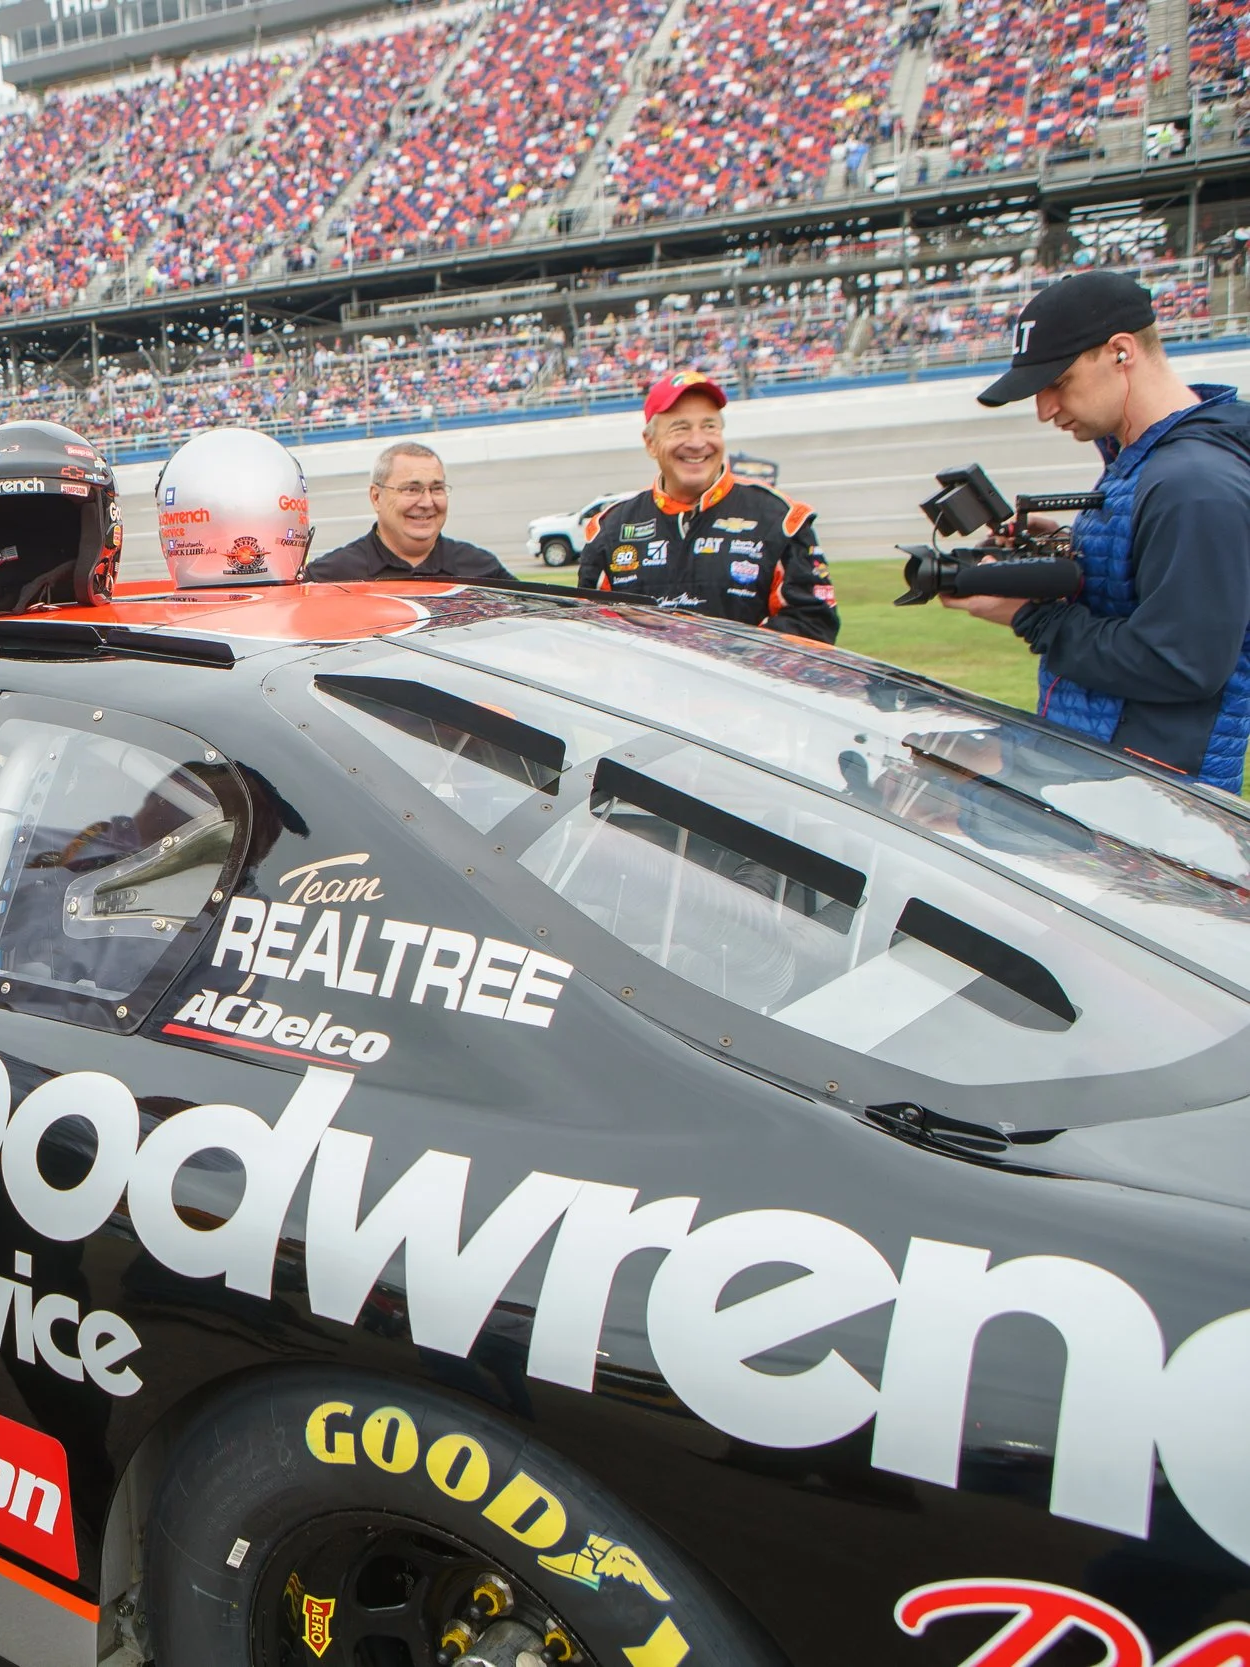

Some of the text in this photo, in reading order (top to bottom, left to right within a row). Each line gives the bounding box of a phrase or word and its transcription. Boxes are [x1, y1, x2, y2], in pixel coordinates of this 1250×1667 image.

[62, 485, 87, 495] SIMPSON
[615, 551, 634, 565] 50
[694, 537, 725, 554] CAT
[279, 853, 384, 904] Team
[211, 896, 574, 1028] REALTREE
[173, 988, 390, 1064] ACDelco
[310, 1602, 324, 1645] AERO
